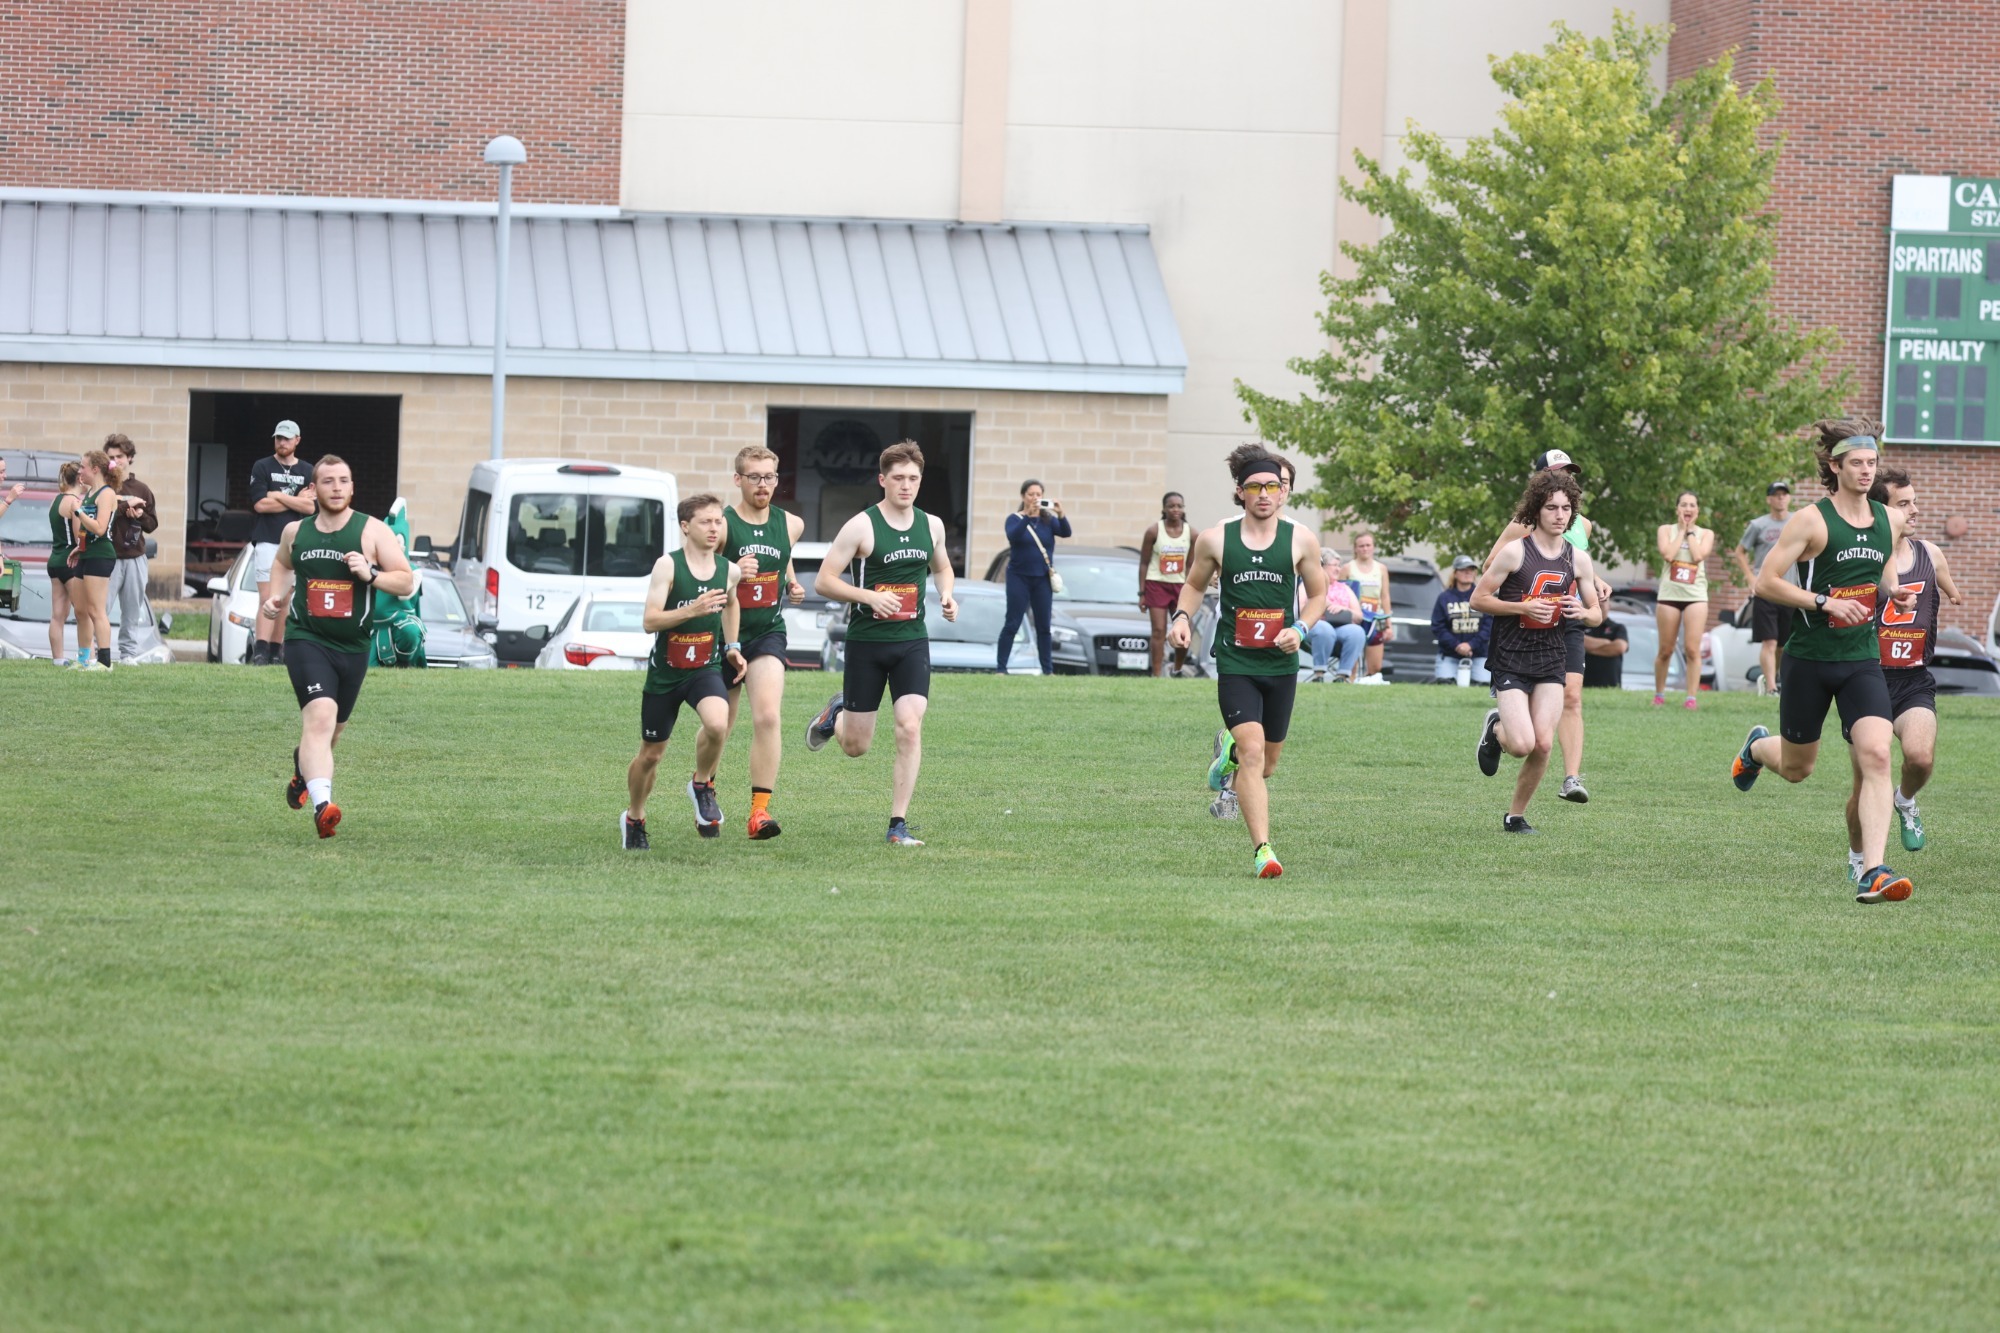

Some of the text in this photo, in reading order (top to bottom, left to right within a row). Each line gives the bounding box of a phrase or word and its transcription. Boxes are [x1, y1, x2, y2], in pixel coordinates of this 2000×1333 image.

[1955, 182, 2000, 208] CA
[1894, 246, 1983, 274] SPARTANS
[1899, 339, 1985, 361] PENALTY
[739, 544, 781, 560] CASTLETON
[883, 549, 928, 564] CASTLETON
[1837, 547, 1884, 564] CASTLETON
[1166, 561, 1178, 572] 24
[1233, 571, 1283, 584] CASTLETON
[324, 592, 335, 610] 5
[526, 594, 545, 610] 12
[752, 585, 762, 602] 3
[1254, 622, 1266, 640] 2
[1880, 629, 1913, 638] Athletic
[685, 645, 696, 662] 4
[1891, 641, 1912, 659] 62
